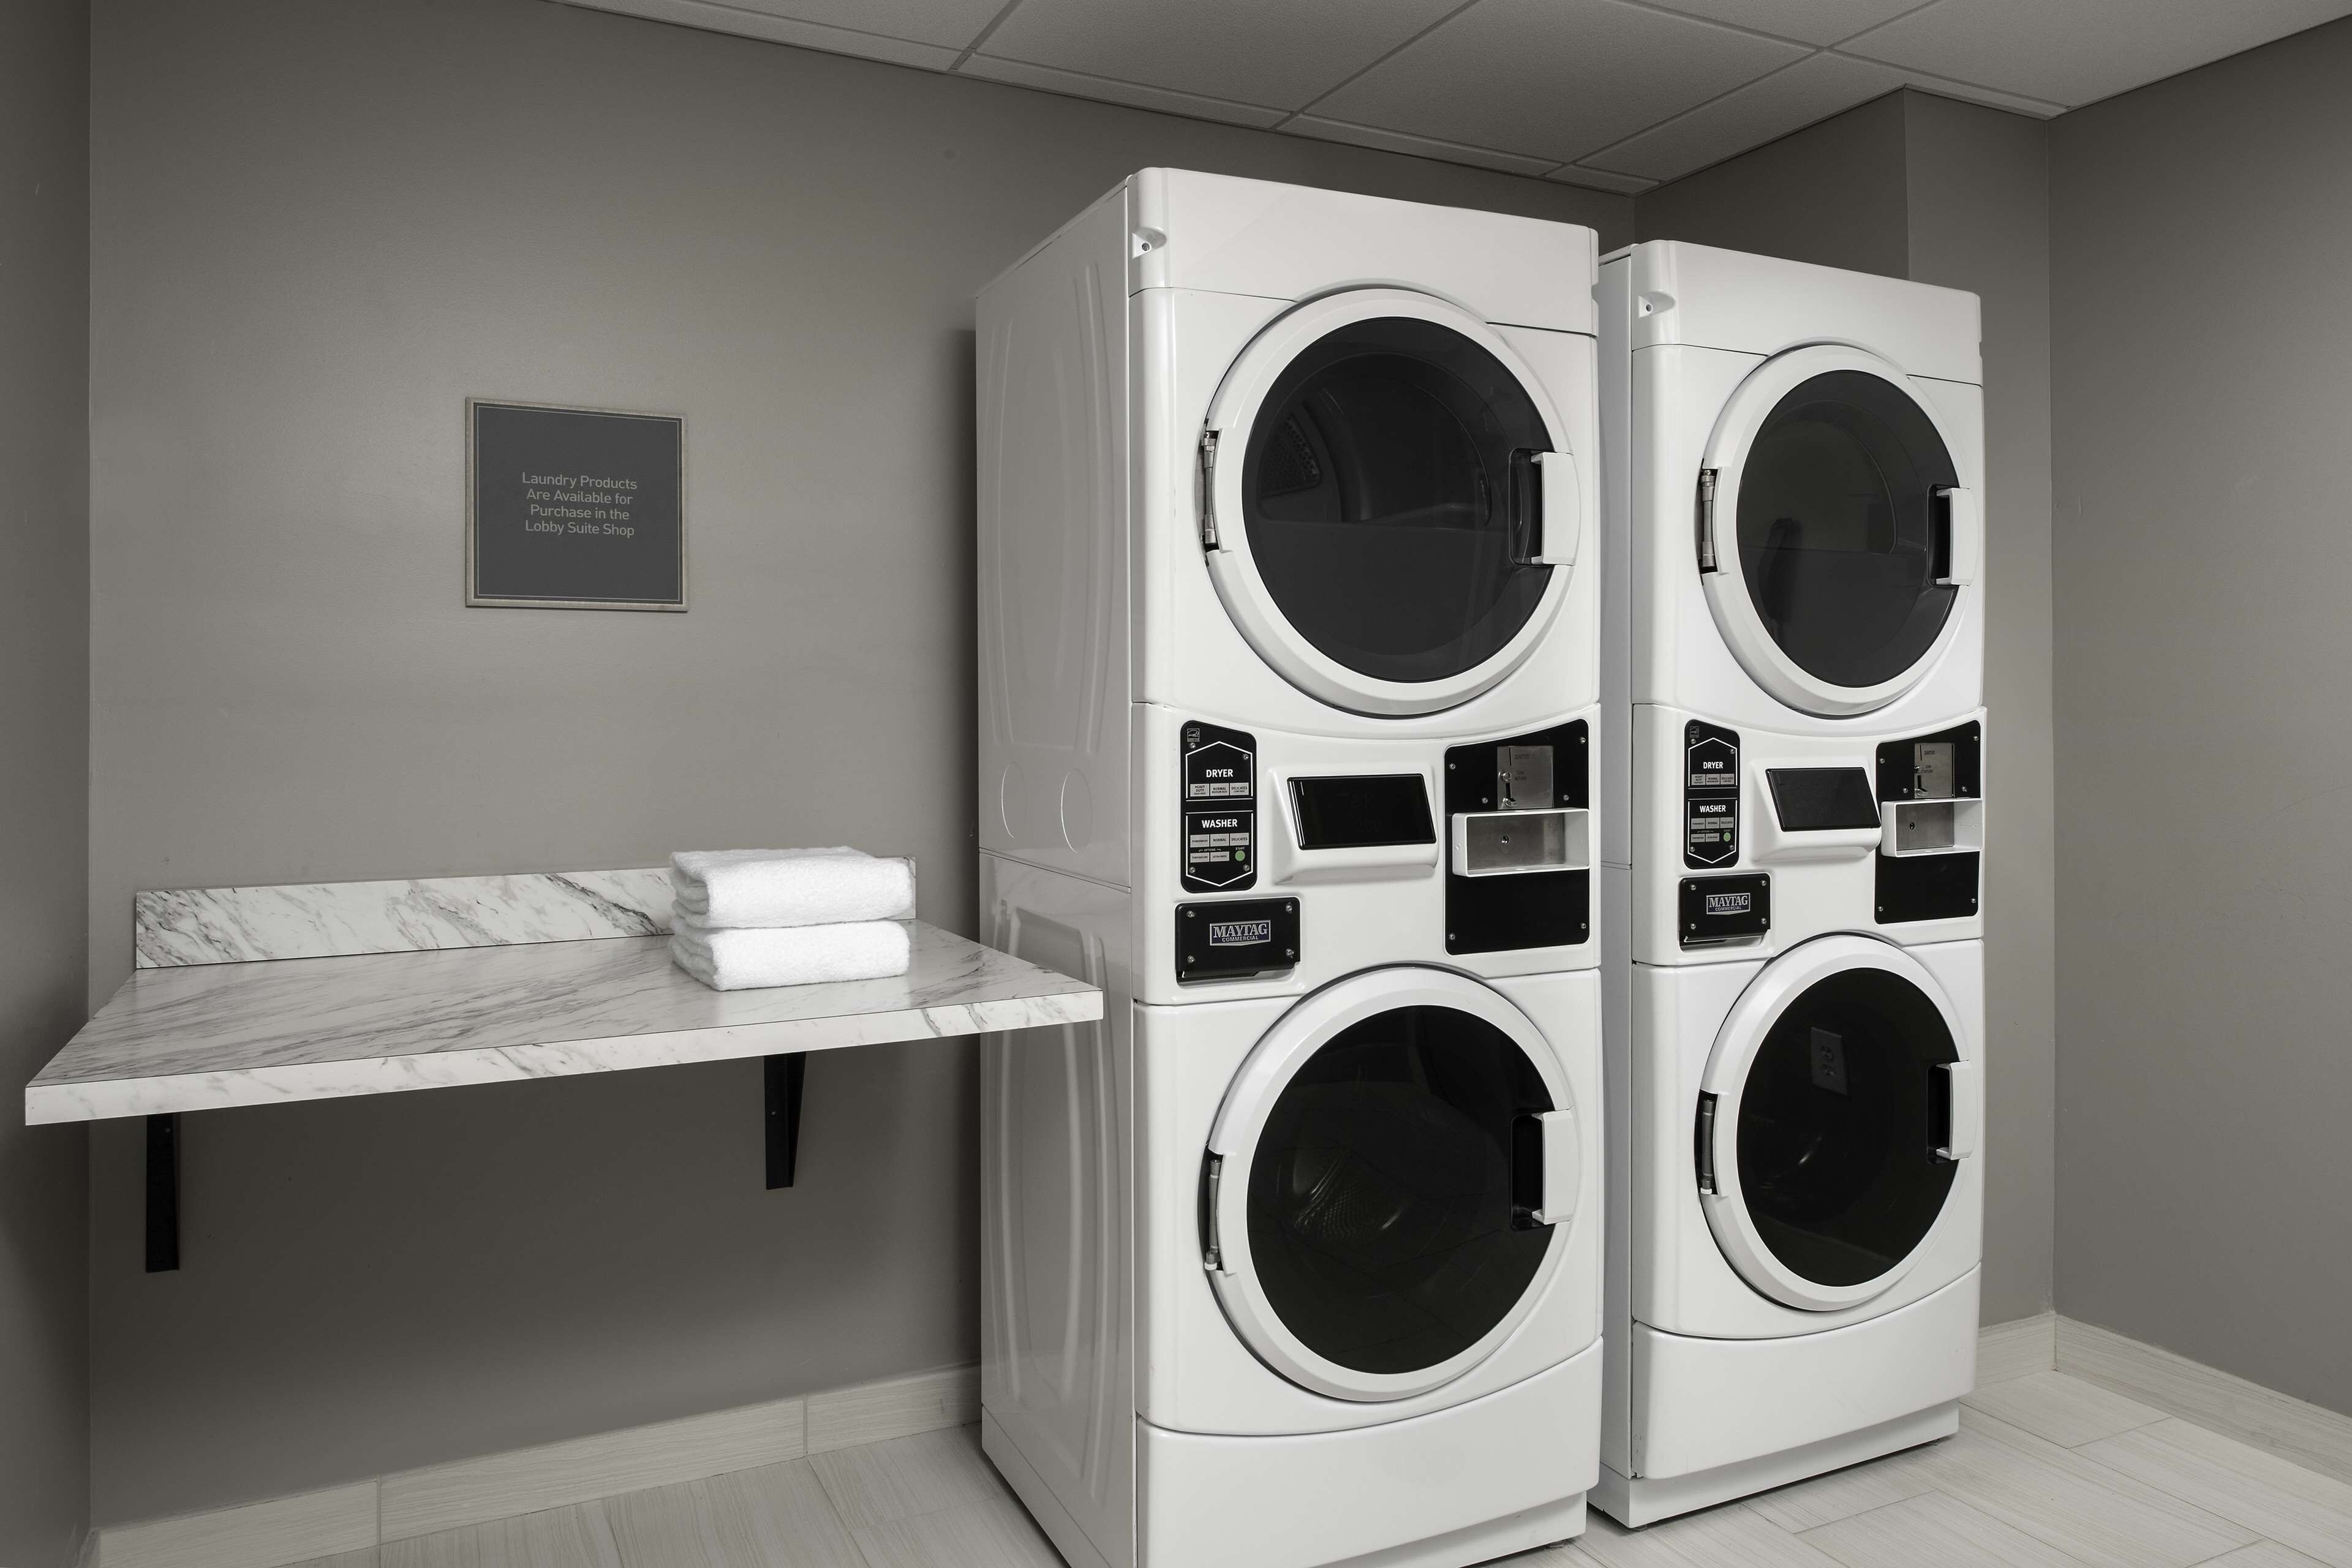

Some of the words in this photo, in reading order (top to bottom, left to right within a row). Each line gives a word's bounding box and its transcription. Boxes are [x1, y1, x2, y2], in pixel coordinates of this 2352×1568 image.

[522, 472, 577, 489] Laundry
[581, 475, 638, 489] Products
[526, 488, 550, 500] Are
[554, 490, 611, 503] Available
[615, 493, 633, 505] for
[530, 504, 591, 518] Purchase
[595, 507, 606, 519] in
[609, 508, 630, 520] the
[526, 519, 564, 535] Lobby
[568, 522, 600, 534] Suite
[603, 523, 635, 538] Shop
[1206, 769, 1234, 778] DRYER
[1202, 819, 1238, 828] WASHER
[1709, 895, 1748, 908] MAYTAG
[1213, 923, 1268, 938] MAYTAG
